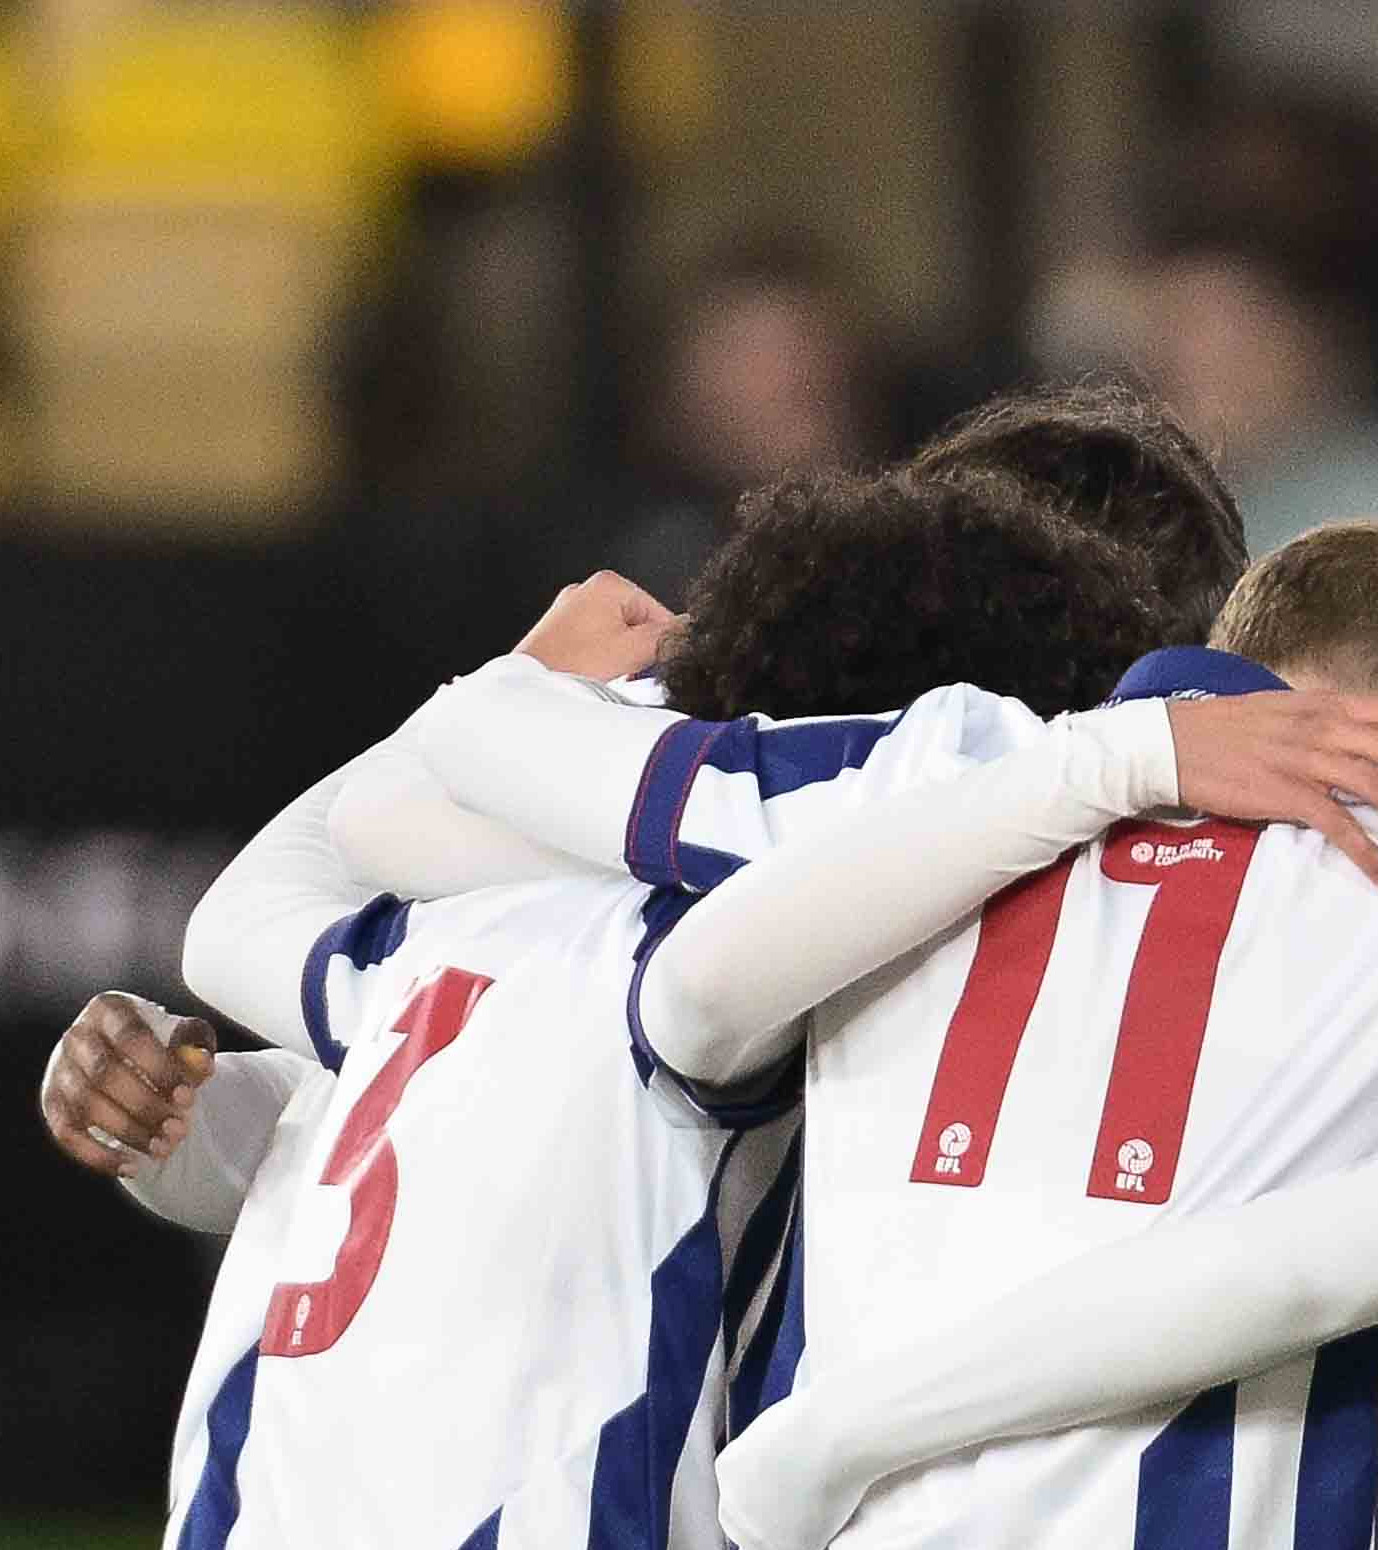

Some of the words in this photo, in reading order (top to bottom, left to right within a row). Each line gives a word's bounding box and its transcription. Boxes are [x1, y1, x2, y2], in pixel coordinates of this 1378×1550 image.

[909, 819, 1262, 1205] 11
[260, 966, 494, 1357] 3
[935, 1156, 962, 1174] EFL
[1114, 1172, 1145, 1192] EFL
